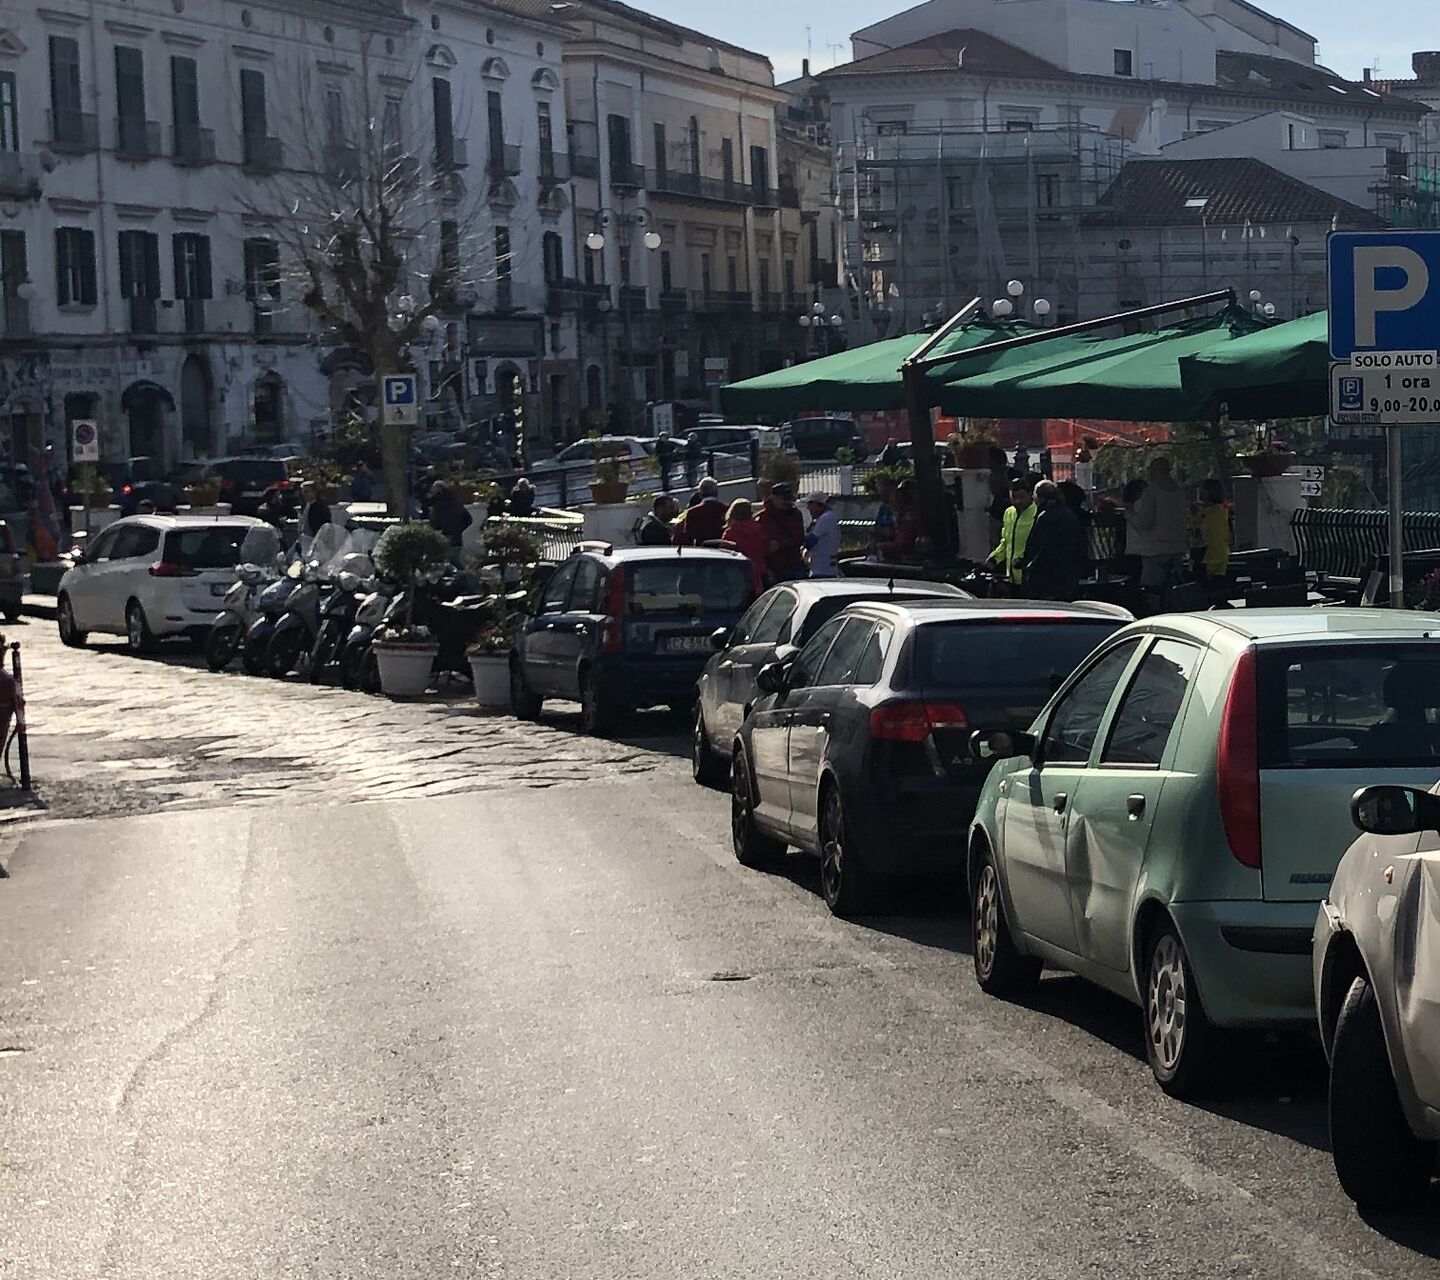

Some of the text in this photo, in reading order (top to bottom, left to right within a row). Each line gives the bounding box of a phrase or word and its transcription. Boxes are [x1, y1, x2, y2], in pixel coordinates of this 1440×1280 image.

[1353, 246, 1429, 346] P
[1355, 354, 1433, 368] SOLO AUTO
[1385, 374, 1431, 389] 1 ora
[391, 382, 408, 401] P
